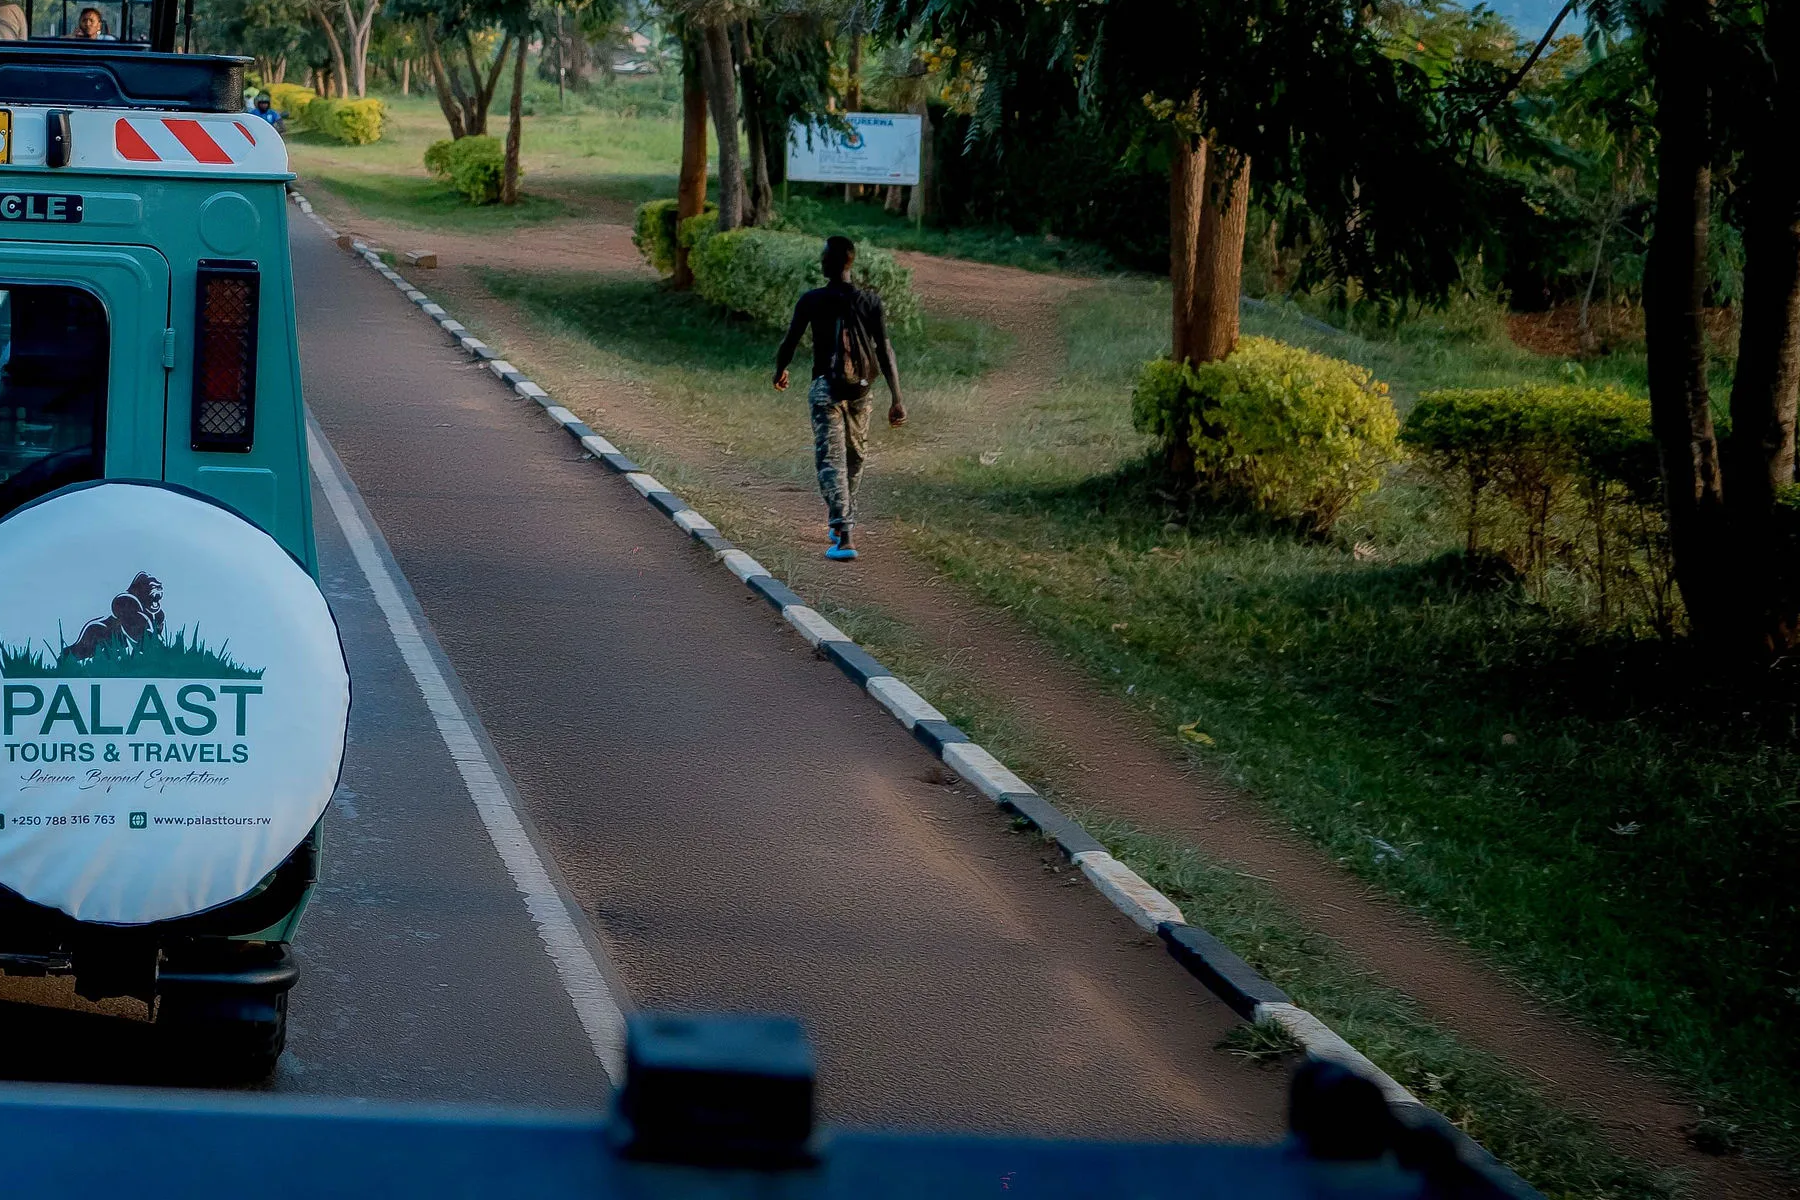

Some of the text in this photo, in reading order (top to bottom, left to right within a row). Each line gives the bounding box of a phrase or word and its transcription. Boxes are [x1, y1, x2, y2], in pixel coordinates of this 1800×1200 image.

[2, 684, 264, 736] PALAST
[4, 743, 249, 763] TOURS & TRAVELS
[20, 769, 230, 793] Leisure Beyond Expectations
[11, 814, 272, 826] +250 788 316 763 www.palasttours.rw
